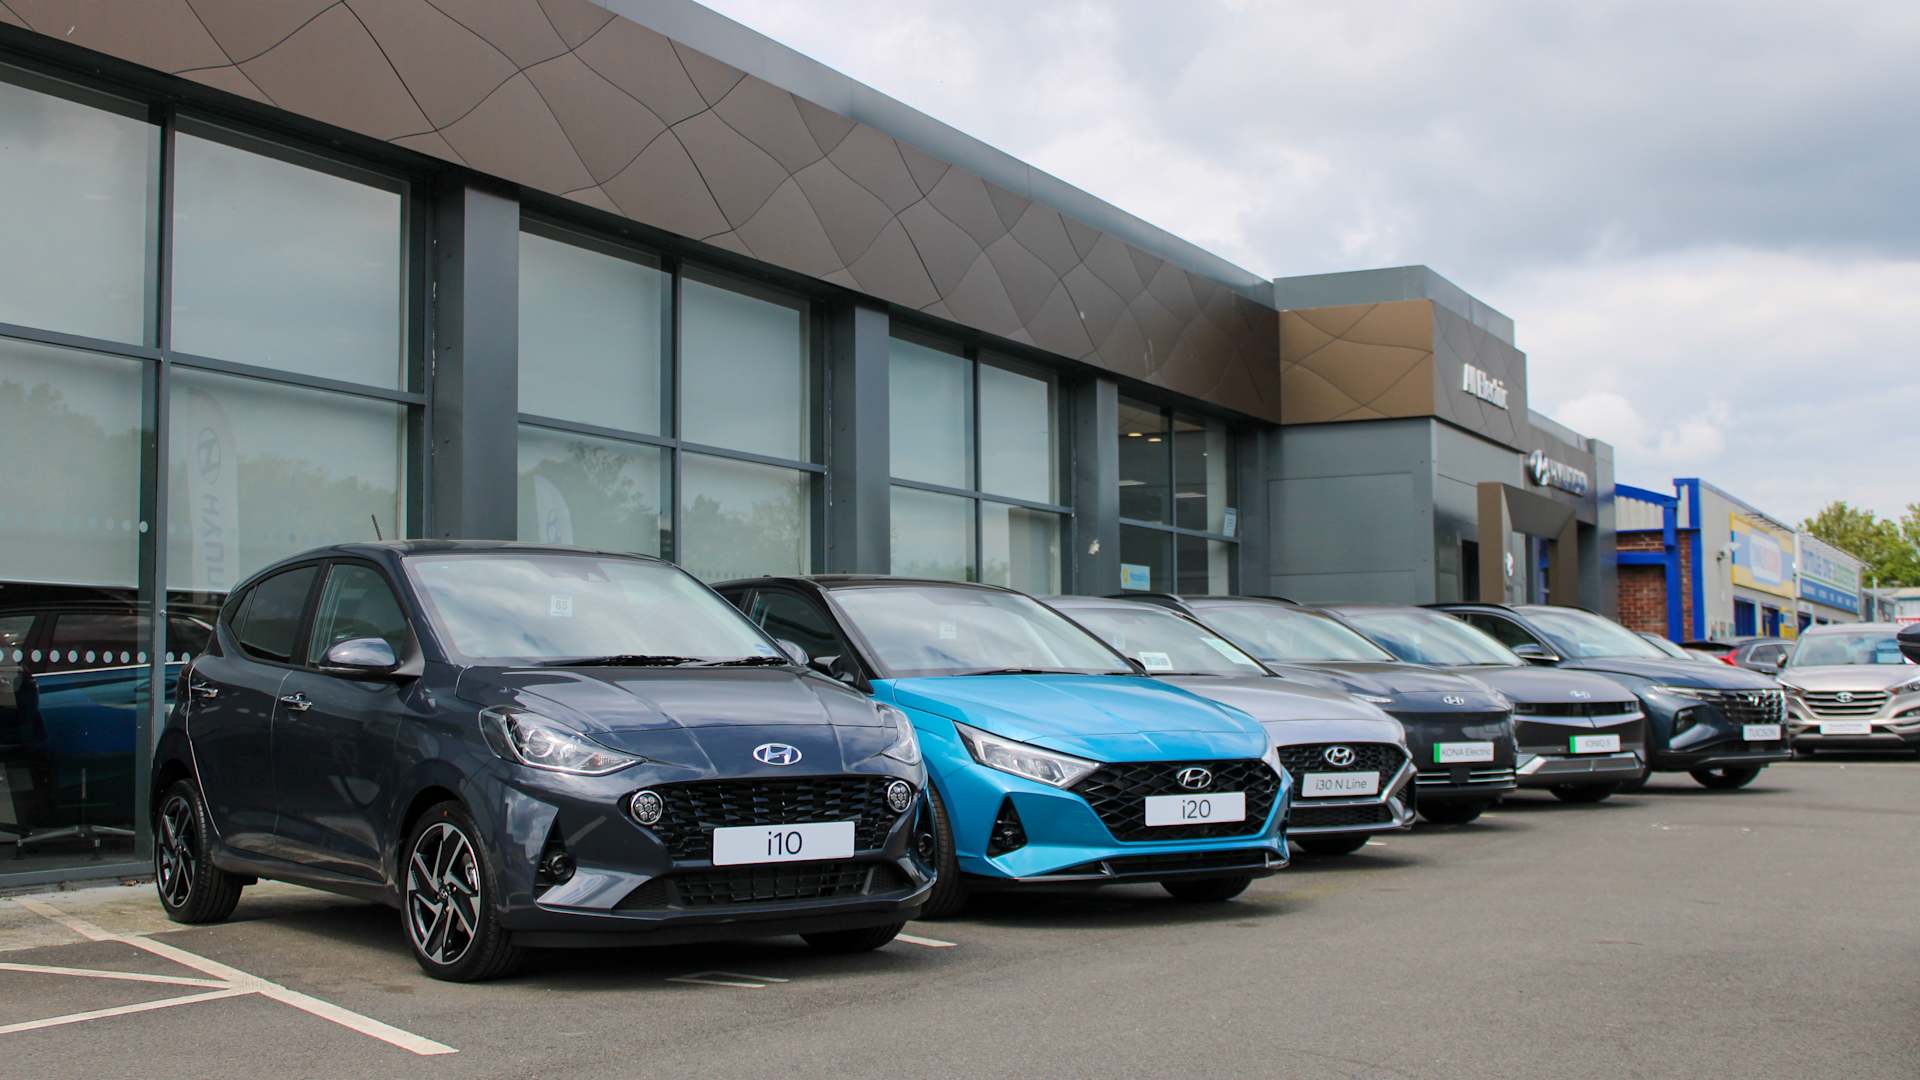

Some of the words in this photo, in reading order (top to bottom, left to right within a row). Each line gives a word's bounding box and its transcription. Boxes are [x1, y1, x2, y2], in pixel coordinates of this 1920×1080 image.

[1315, 779, 1333, 791] i30
[1335, 779, 1344, 790] N
[1345, 777, 1368, 790] Line
[1182, 799, 1212, 820] i20
[767, 830, 803, 856] i10
